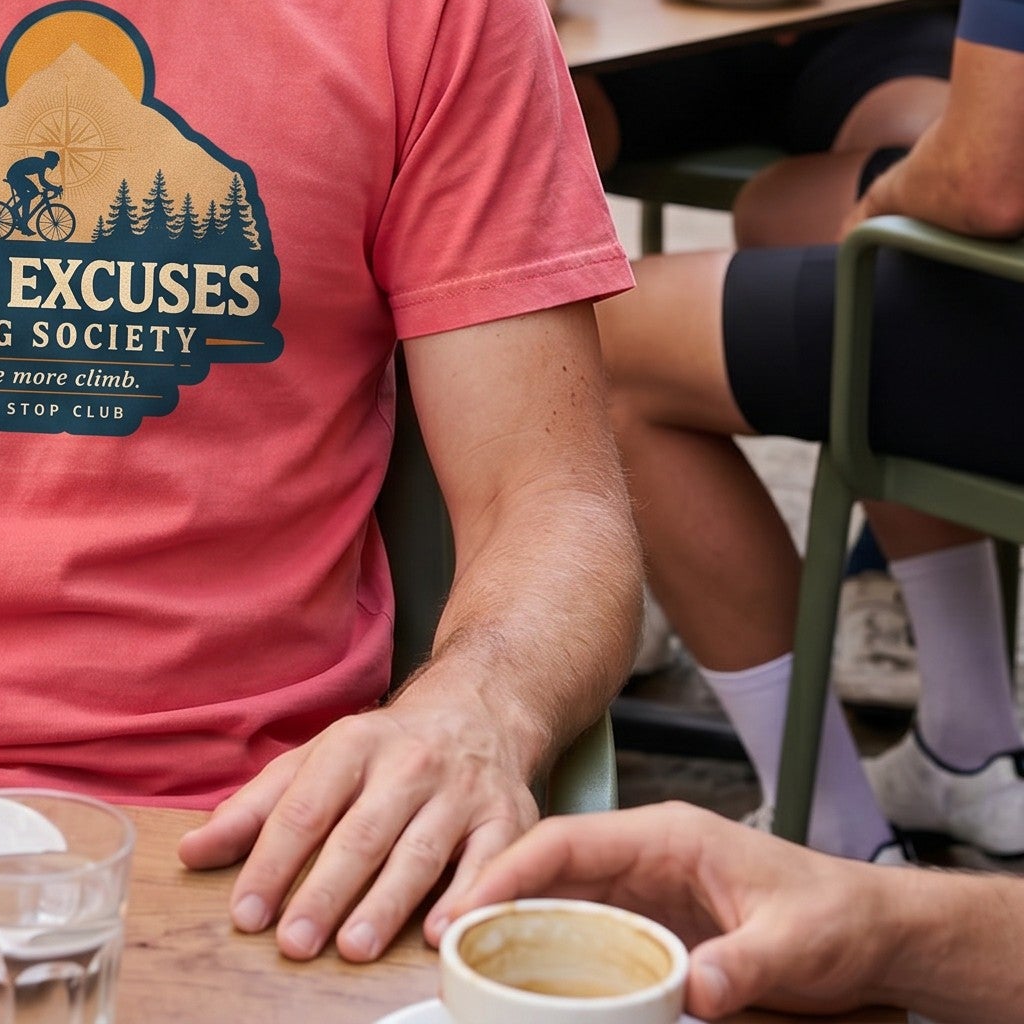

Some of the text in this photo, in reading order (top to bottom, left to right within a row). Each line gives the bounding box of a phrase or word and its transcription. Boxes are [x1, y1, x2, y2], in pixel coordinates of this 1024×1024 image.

[6, 256, 260, 318] EXCUSES
[32, 321, 197, 355] SOCIETY
[12, 371, 68, 386] more
[74, 368, 141, 389] climb.
[6, 402, 59, 417] STOP
[72, 405, 124, 419] CLUB
